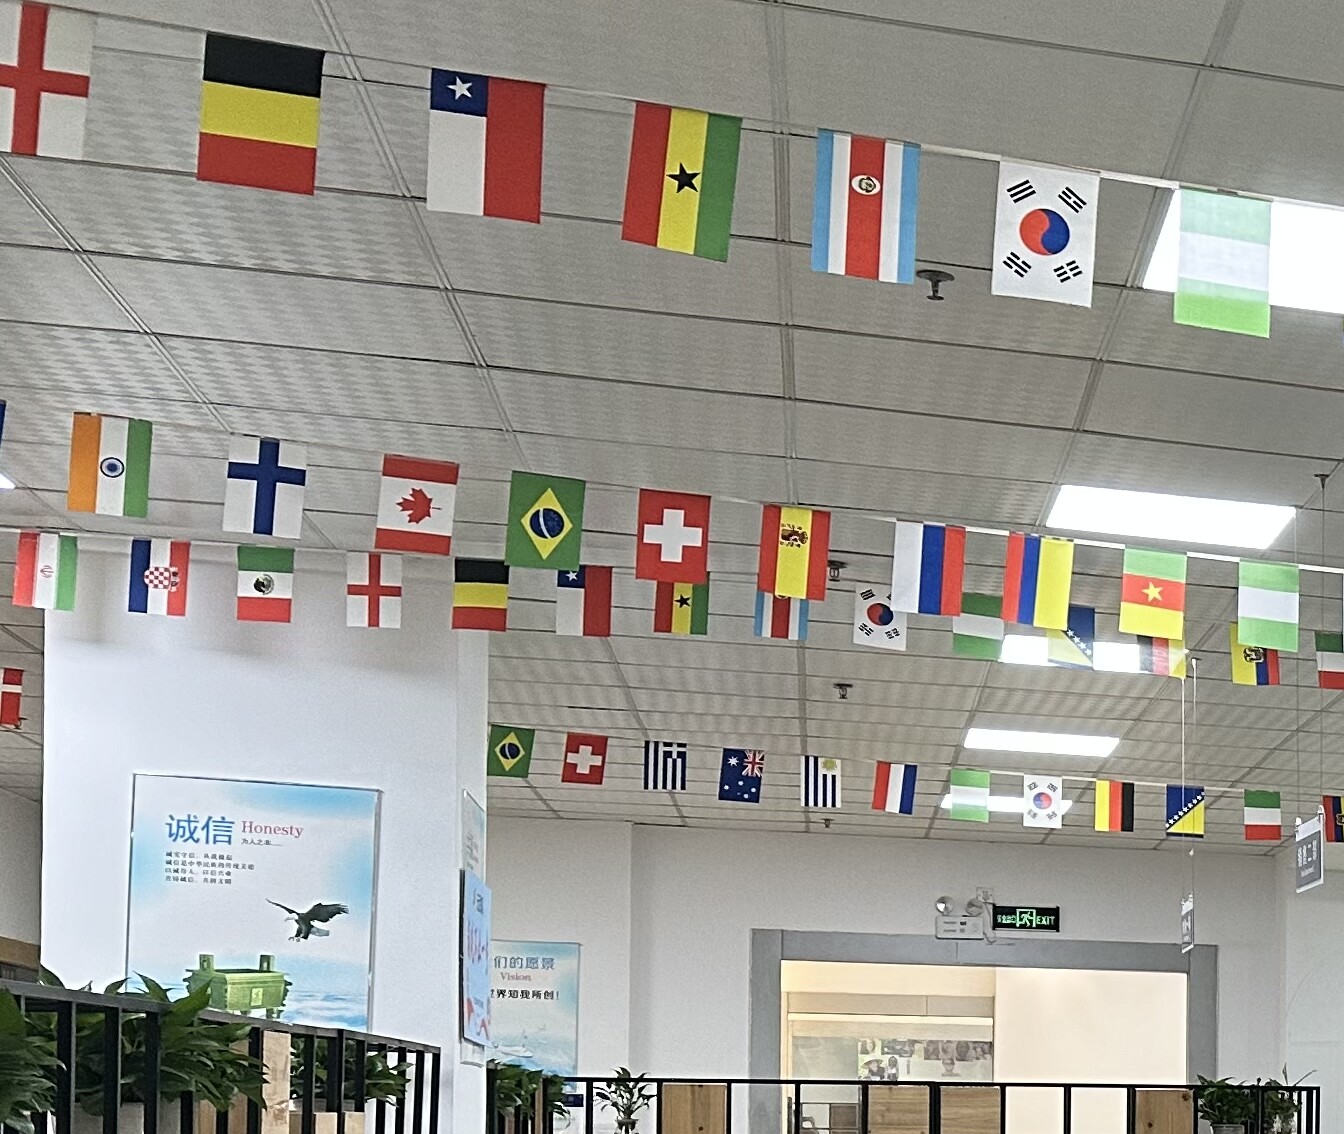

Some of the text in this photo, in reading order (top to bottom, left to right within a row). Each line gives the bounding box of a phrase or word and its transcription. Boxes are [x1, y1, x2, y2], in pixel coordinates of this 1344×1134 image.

[165, 814, 235, 845] 诚信
[242, 820, 304, 838] Honesty
[1036, 915, 1056, 926] EXIT
[500, 971, 532, 981] Vision
